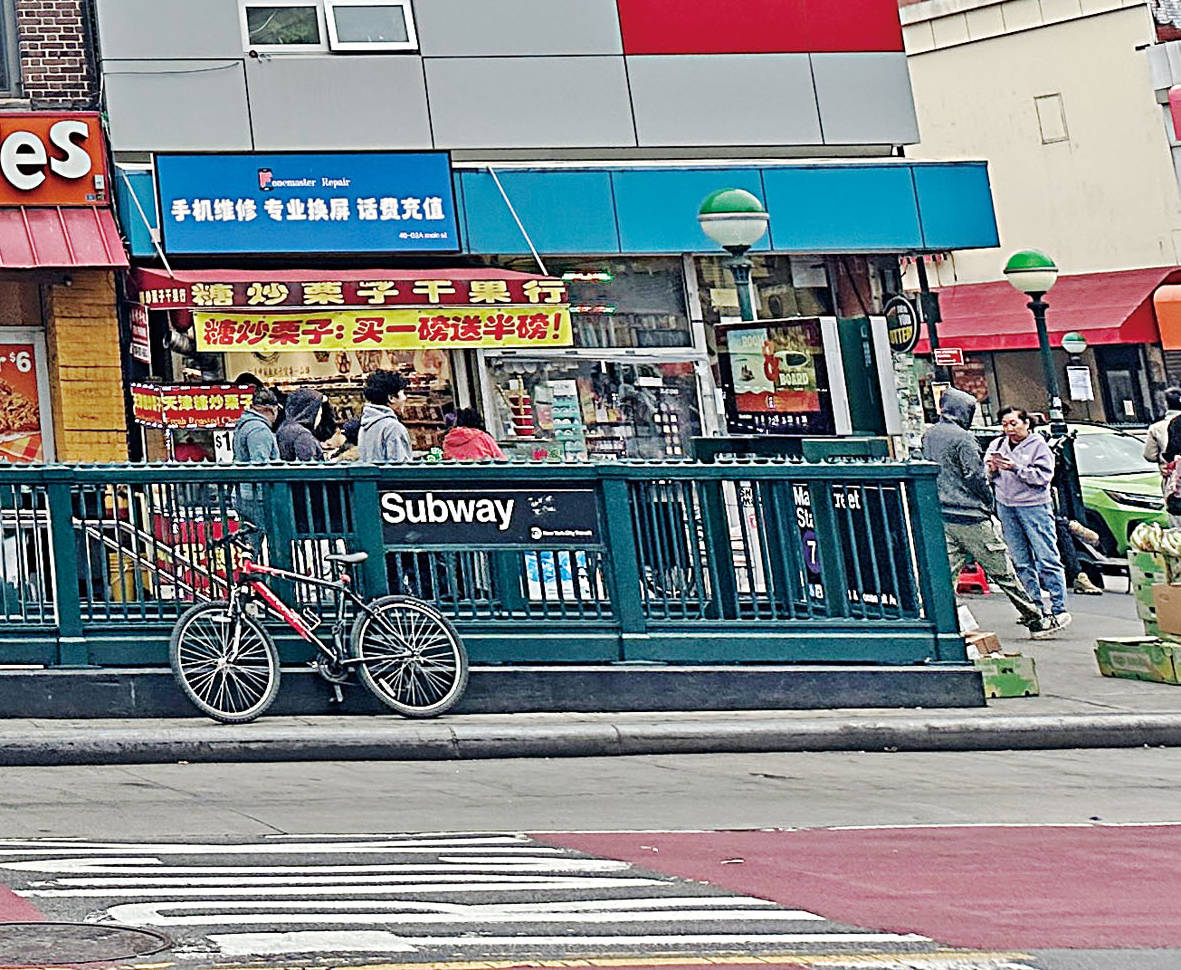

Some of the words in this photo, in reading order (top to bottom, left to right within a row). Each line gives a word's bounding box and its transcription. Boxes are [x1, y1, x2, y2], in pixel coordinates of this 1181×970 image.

[322, 177, 351, 189] Repair
[171, 198, 257, 222] 手机维修
[264, 197, 351, 221] 专业换屏
[357, 196, 445, 220] 话费充值
[191, 279, 567, 307] 糖炒栗子干果行
[9, 351, 31, 372] $6
[779, 373, 809, 386] BOARD
[381, 492, 515, 531] Subway
[806, 540, 817, 564] 7
